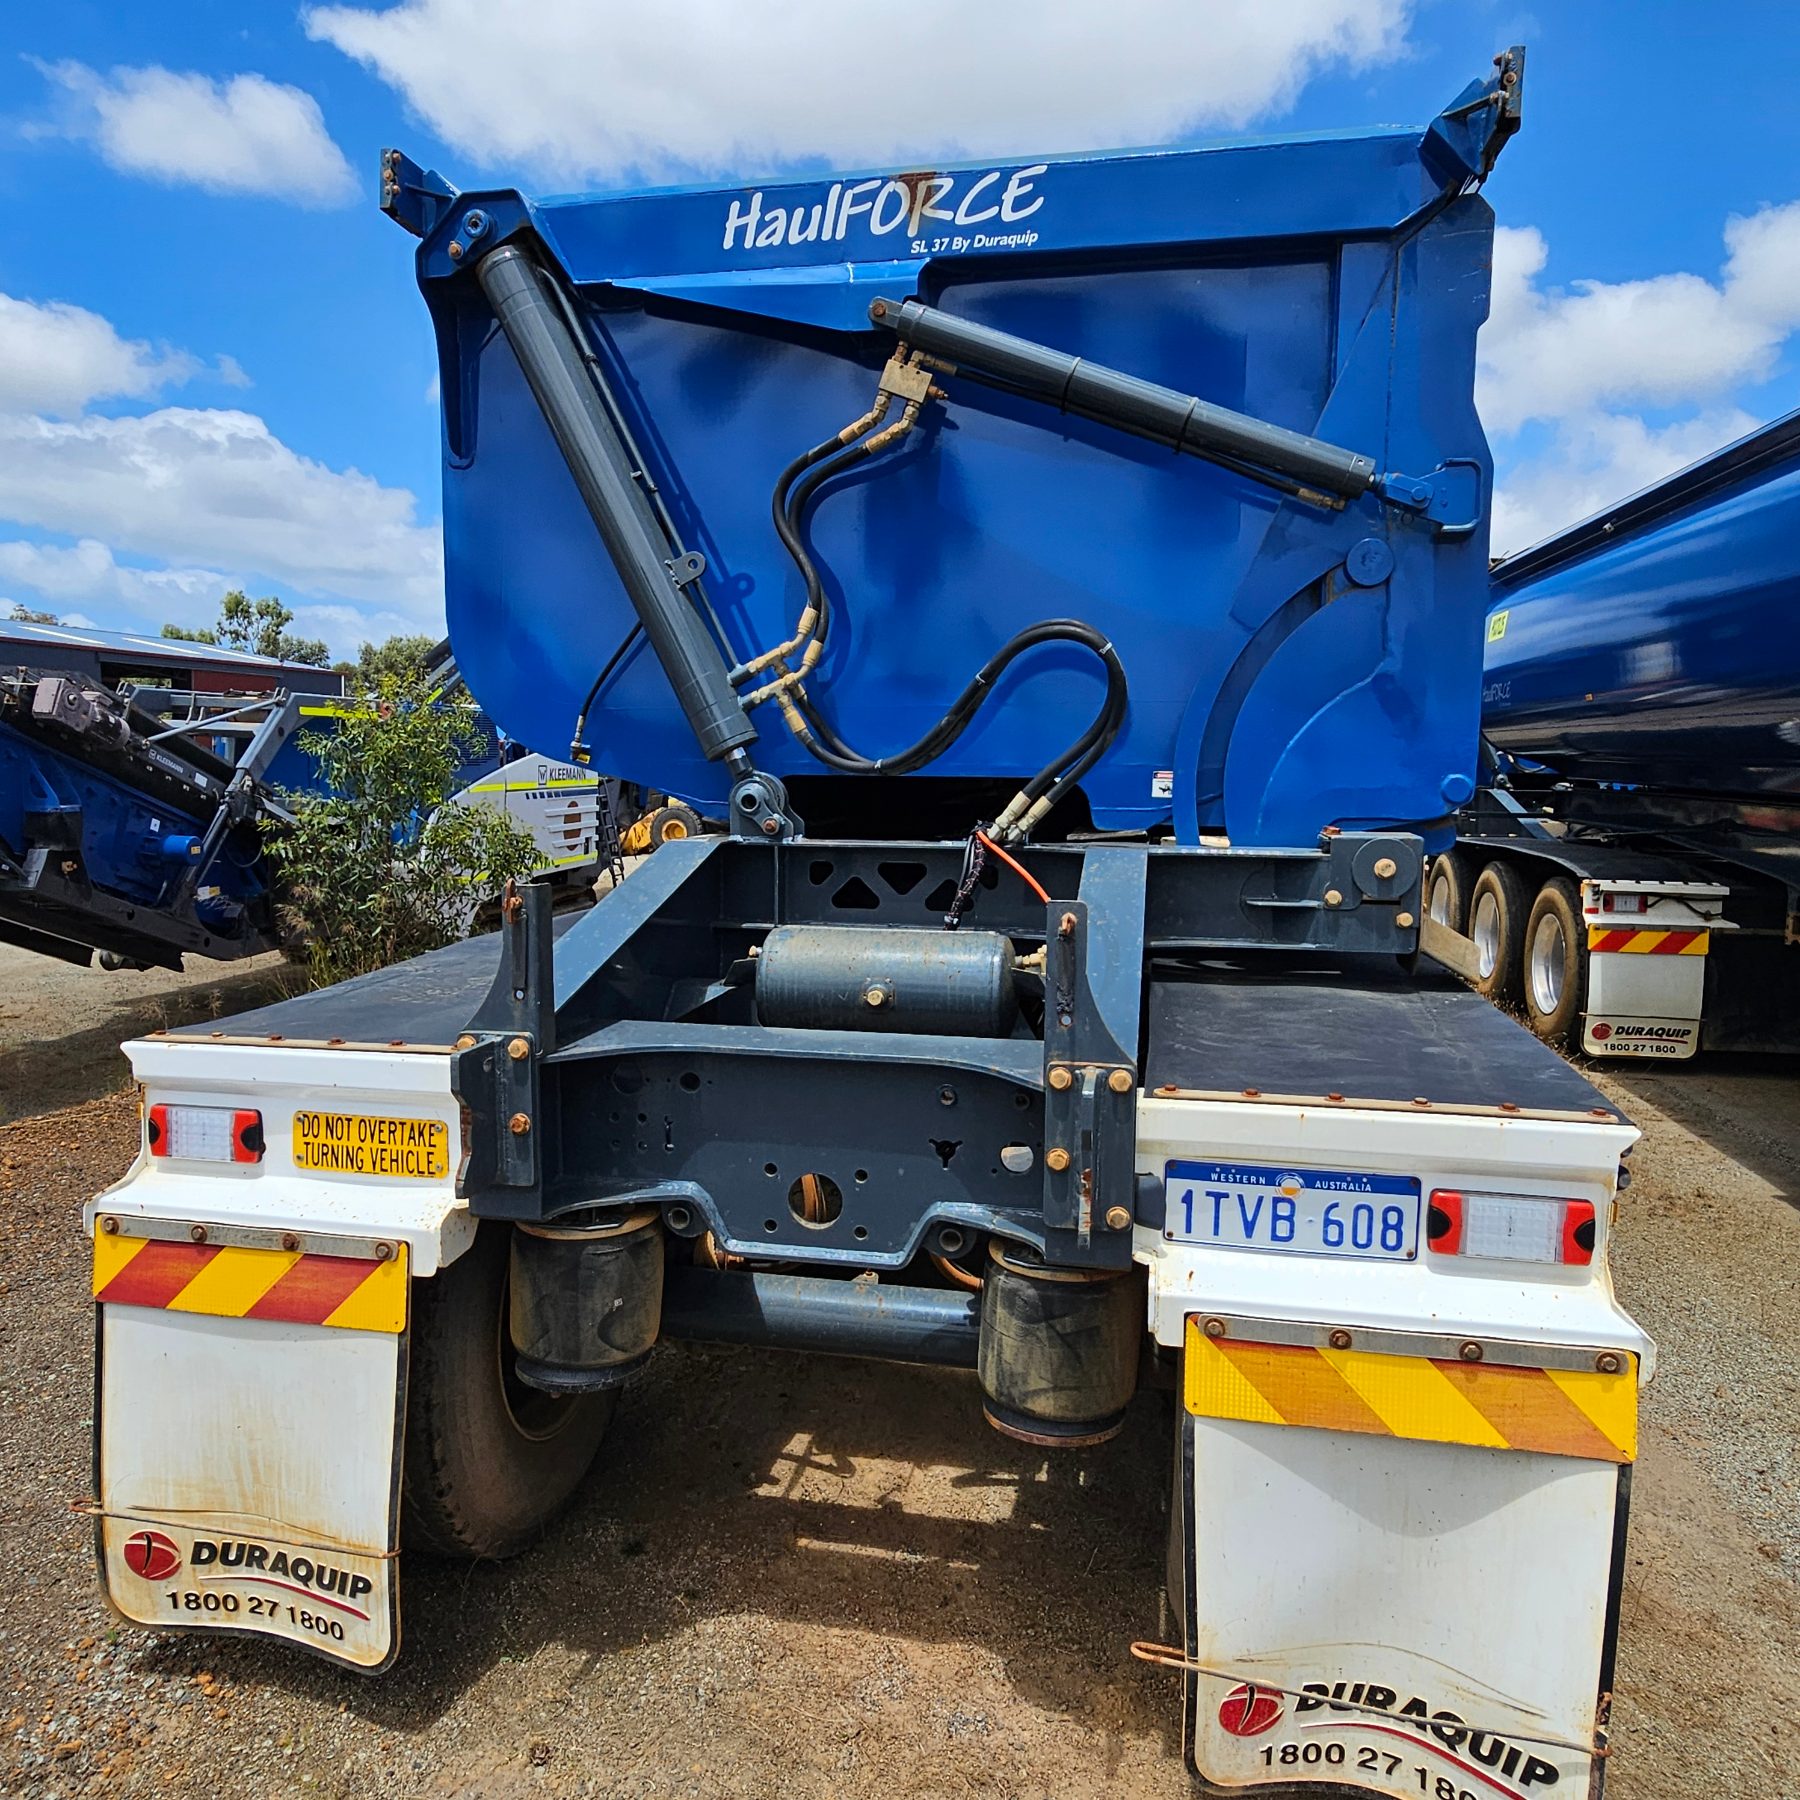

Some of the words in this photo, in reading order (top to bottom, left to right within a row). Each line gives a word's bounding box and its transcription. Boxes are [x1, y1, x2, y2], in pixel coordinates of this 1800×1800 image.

[723, 165, 1048, 250] HaulFORCE
[911, 240, 929, 254] SL
[931, 238, 950, 252] 37
[952, 236, 971, 253] By
[973, 229, 1039, 249] Duraquip
[549, 767, 586, 781] KLEEMANN
[1603, 1043, 1630, 1051] 1800
[1632, 1044, 1646, 1052] 27
[1649, 1045, 1676, 1054] 1800
[1614, 1025, 1692, 1038] DURAQUIP
[302, 1114, 320, 1139] DO
[325, 1116, 352, 1142] NOT
[358, 1119, 437, 1148] OVERTAKE
[304, 1142, 364, 1171] TURNING
[370, 1148, 436, 1175] VEHICLE
[1210, 1172, 1266, 1185] WESTERN
[1314, 1180, 1372, 1192] AUSTRALIA
[1181, 1189, 1296, 1243] 1TVB
[1322, 1202, 1404, 1252] 608
[190, 1540, 373, 1600] DURAQUIP
[165, 1590, 240, 1612] 1800
[247, 1596, 280, 1617] 27
[286, 1605, 345, 1641] 1800
[1294, 1682, 1560, 1787] DURAQUIP
[1259, 1742, 1346, 1766] 1800
[1357, 1746, 1403, 1776] 27
